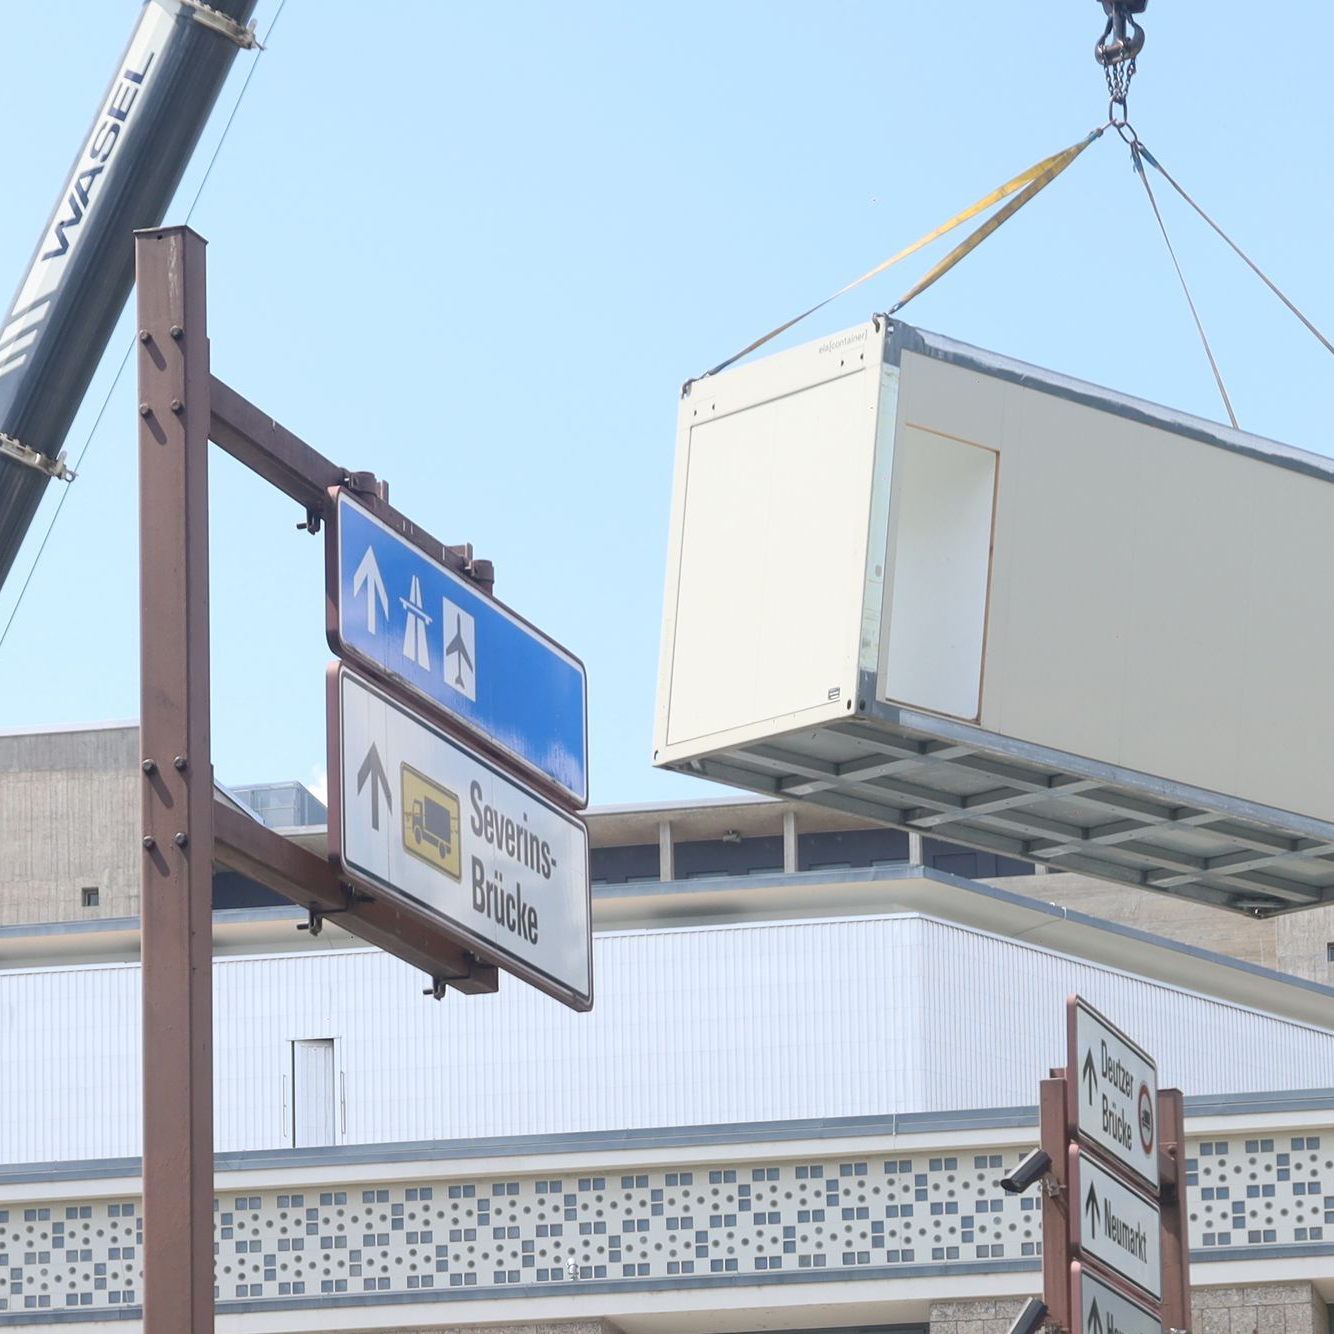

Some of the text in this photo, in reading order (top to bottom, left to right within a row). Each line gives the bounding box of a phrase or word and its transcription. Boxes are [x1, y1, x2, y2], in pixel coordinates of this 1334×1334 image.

[41, 50, 155, 261] WASEL
[469, 779, 557, 880] Severins-
[471, 855, 539, 945] Brücke
[1101, 1039, 1134, 1101] Deutzer
[1102, 1093, 1133, 1152] Brücke
[1104, 1197, 1147, 1265] Neumarkt
